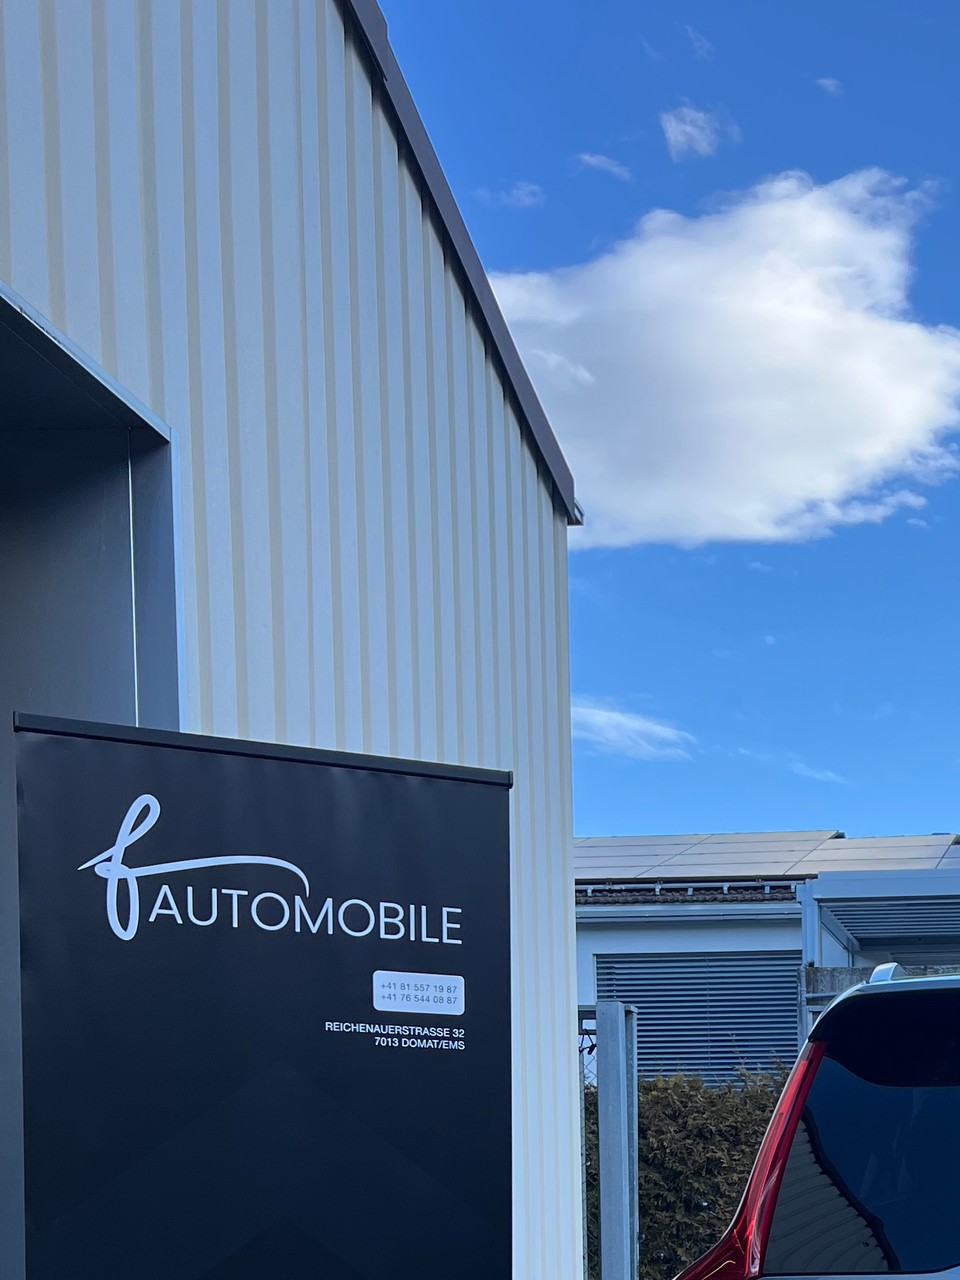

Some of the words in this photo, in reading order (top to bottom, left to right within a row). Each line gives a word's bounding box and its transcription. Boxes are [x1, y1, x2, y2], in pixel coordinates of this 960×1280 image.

[148, 884, 463, 945] AUTOMOBILE
[381, 982, 397, 991] +41
[400, 982, 411, 992] 81
[413, 983, 431, 993] 557
[433, 984, 444, 994] 19
[446, 985, 457, 994] 87
[381, 993, 397, 1002] +41
[400, 993, 412, 1003] 76
[413, 994, 431, 1004] 544
[433, 995, 444, 1005] 08
[446, 996, 457, 1005] 87
[325, 1021, 450, 1037] REICHENAUERSTRASSE
[452, 1028, 465, 1038] 32
[374, 1037, 399, 1047] 7013
[401, 1038, 465, 1050] DOMAT/EMS
